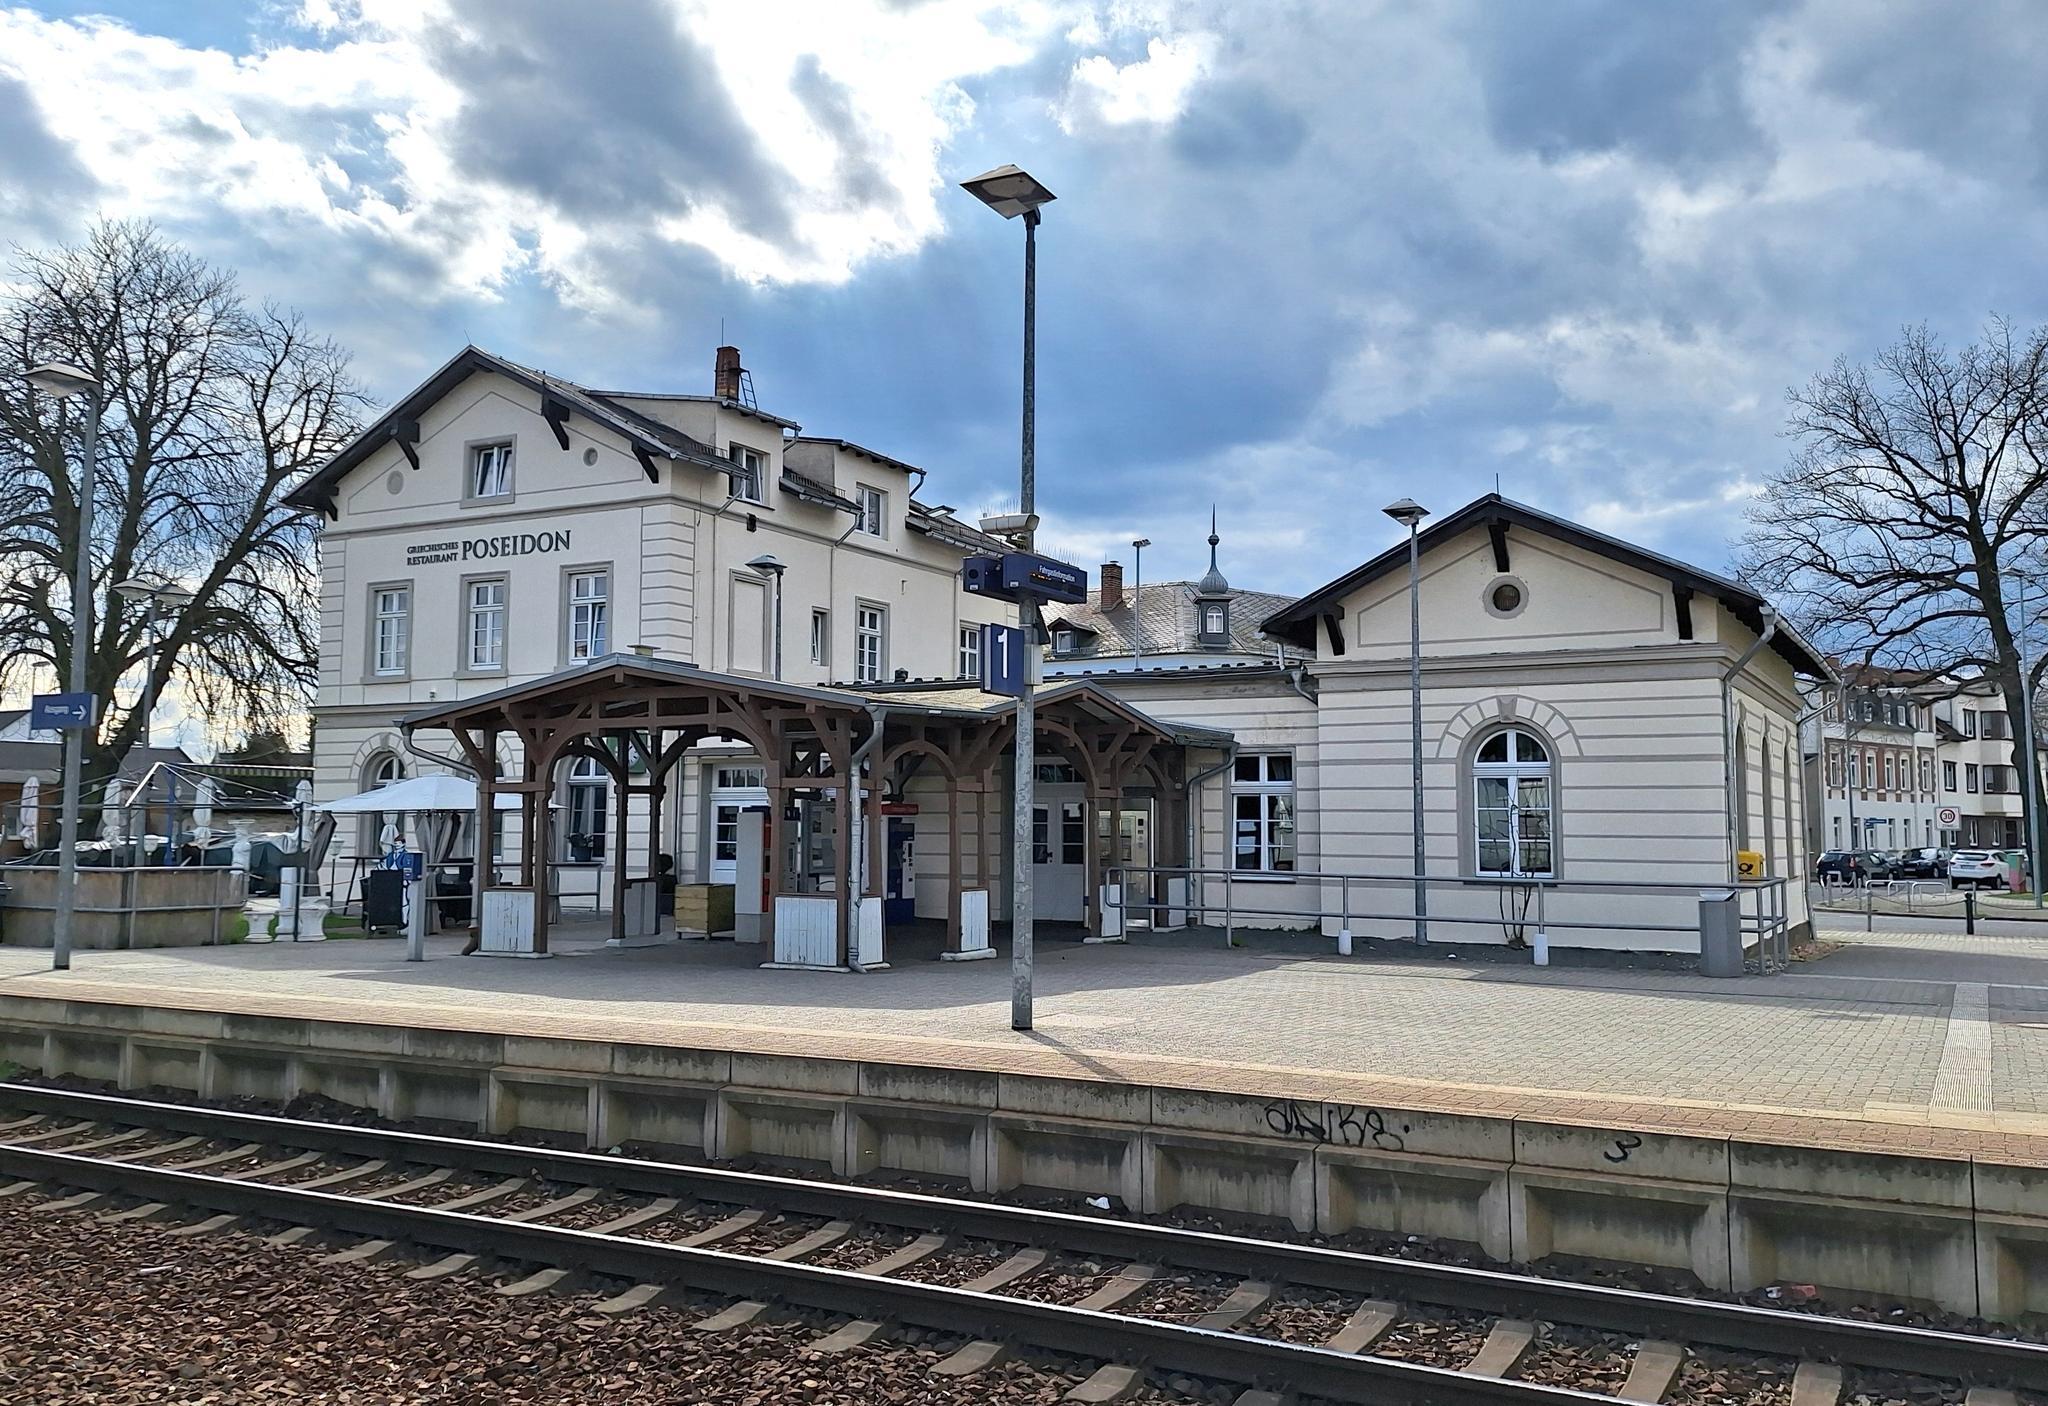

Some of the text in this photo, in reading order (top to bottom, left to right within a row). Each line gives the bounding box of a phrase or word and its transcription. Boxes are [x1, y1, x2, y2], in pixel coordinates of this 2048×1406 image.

[407, 541, 459, 554] GRIECHISCHES
[461, 530, 571, 560] POSEIDON
[407, 552, 459, 566] RESTAURANT
[997, 628, 1008, 679] 1
[1942, 812, 1953, 820] 30
